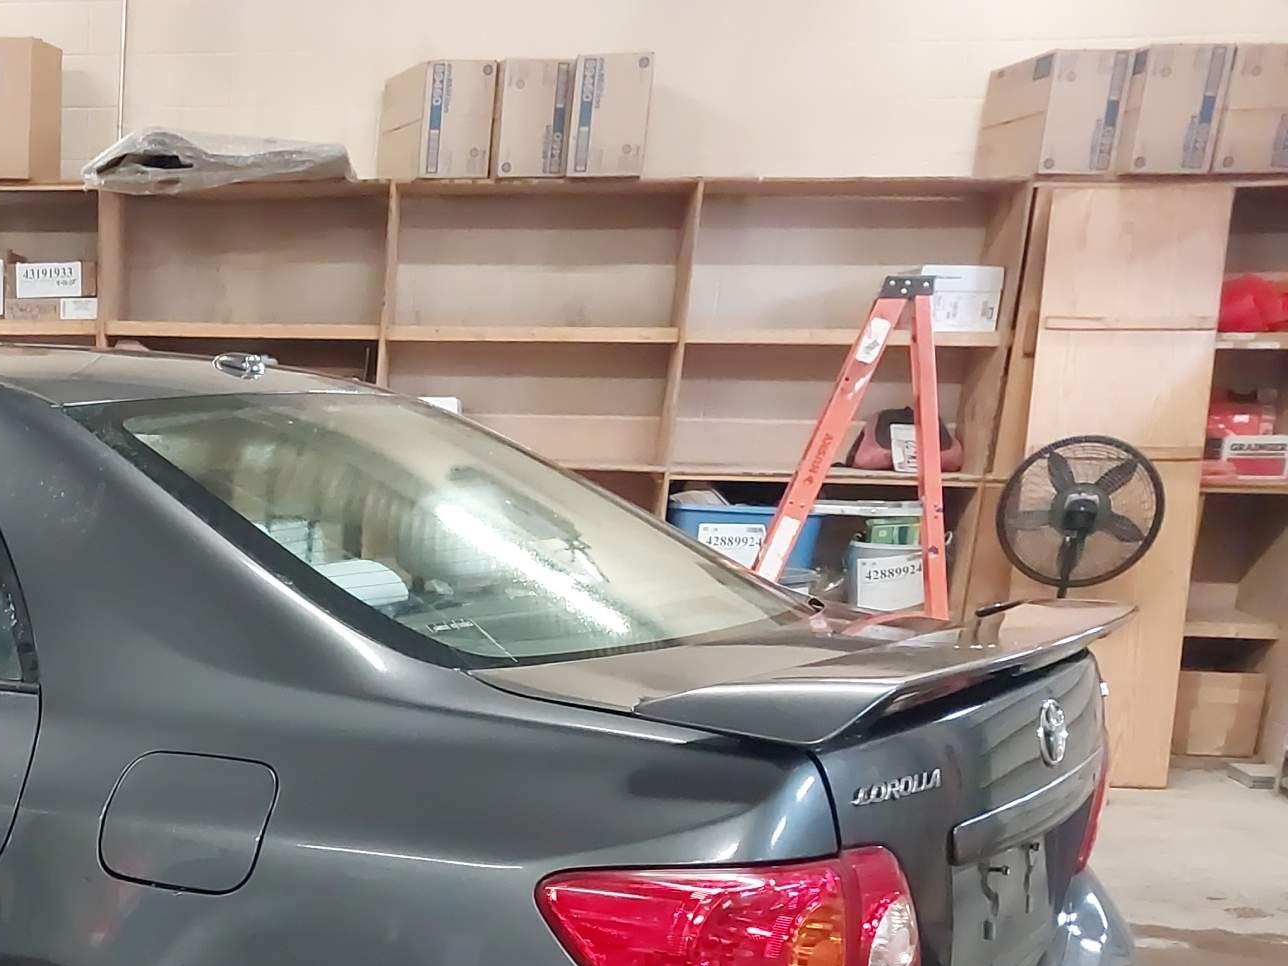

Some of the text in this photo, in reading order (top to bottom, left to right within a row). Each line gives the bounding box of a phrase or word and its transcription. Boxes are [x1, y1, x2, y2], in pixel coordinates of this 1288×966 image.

[22, 267, 74, 280] 43191933
[705, 535, 762, 547] 42889924
[865, 562, 922, 580] 42889924
[850, 768, 942, 806] COROLLA
